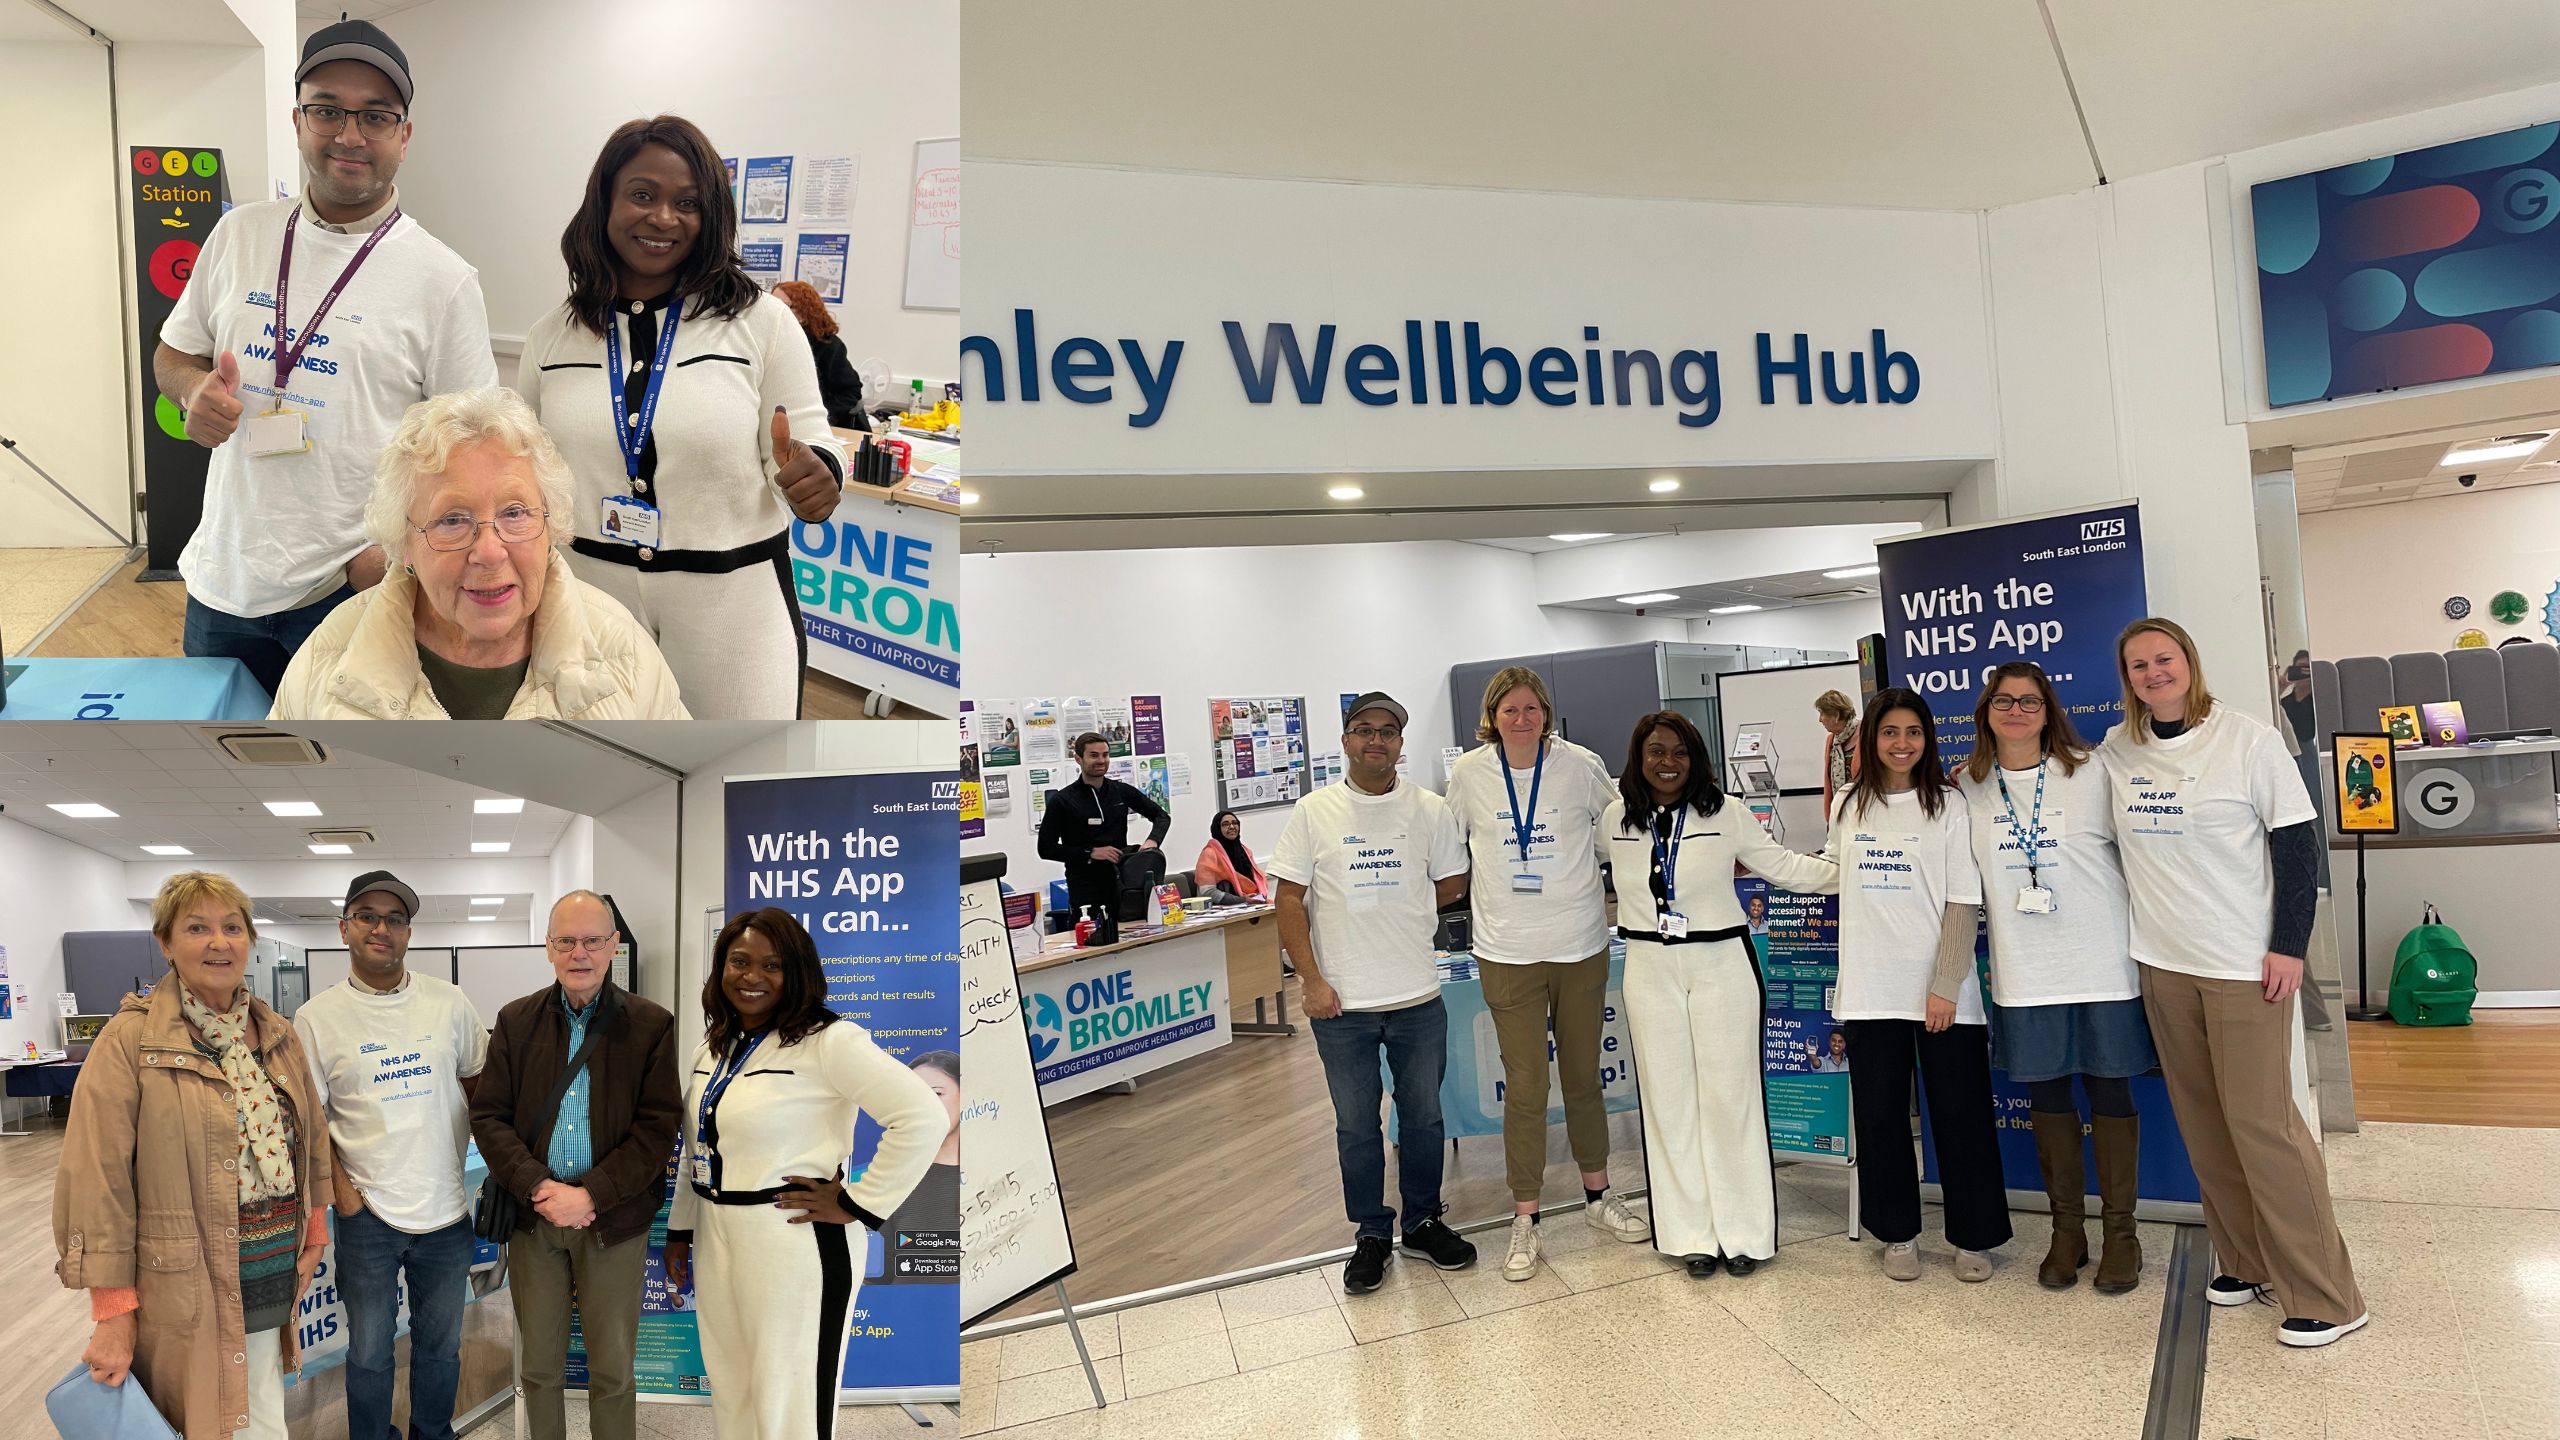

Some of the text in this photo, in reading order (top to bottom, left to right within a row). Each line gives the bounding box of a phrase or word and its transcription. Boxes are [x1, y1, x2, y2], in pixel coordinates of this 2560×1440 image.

[142, 185, 211, 203] Station
[2503, 179, 2549, 222] G
[298, 292, 337, 346] Bromley Healthcare
[263, 323, 296, 341] NS
[1221, 319, 1722, 428] Wellbeing
[1756, 328, 1920, 405] Hub
[2082, 520, 2123, 539] NHS
[791, 515, 933, 590] ONE
[2023, 539, 2126, 562] South East London
[1901, 578, 2054, 621] With the
[1904, 619, 2063, 658] NHS App
[845, 633, 867, 650] TO
[872, 641, 949, 678] IMPROVE
[1906, 664, 1970, 696] you
[2072, 702, 2110, 715] time of
[2139, 792, 2176, 800] NHS APP
[2421, 781, 2458, 816] G
[873, 803, 903, 813] South
[907, 802, 929, 812] East
[2127, 805, 2184, 815] AWARENESS
[748, 828, 899, 862] With the
[1867, 849, 1903, 858] NHS APP
[1349, 861, 1402, 870] AWARENESS
[1858, 862, 1912, 872] AWARENESS
[750, 867, 904, 902] NHS App
[1769, 895, 1826, 905] Need support
[1768, 907, 1823, 917] accessing the
[822, 909, 909, 934] can...
[1768, 918, 1805, 926] internet?
[1768, 929, 1787, 938] here
[1800, 929, 1821, 940] help.
[821, 952, 960, 966] prescriptions any time of day
[963, 977, 978, 991] IN
[861, 990, 935, 1000] and test results
[1066, 969, 1134, 1016] ONE
[968, 986, 1011, 1015] CHECK
[1069, 980, 1213, 1053] BROMLEY
[1767, 1019, 1801, 1030] Did you
[1767, 1030, 1792, 1038] know
[1058, 1019, 1213, 1074] TOGETHER TO IMPROVE HEALTH AND CARE
[1767, 1040, 1804, 1049] with the
[381, 1053, 421, 1067] NHS APP
[1767, 1050, 1806, 1062] NHS App
[1766, 1062, 1807, 1072] you can...
[374, 1066, 431, 1083] AWARENESS
[2010, 1117, 2033, 1129] the
[916, 1238, 960, 1247] Google Play
[914, 1264, 958, 1273] App Store
[646, 1279, 663, 1288] the
[645, 1290, 666, 1301] App
[643, 1302, 668, 1310] can...
[866, 1325, 895, 1338] App.
